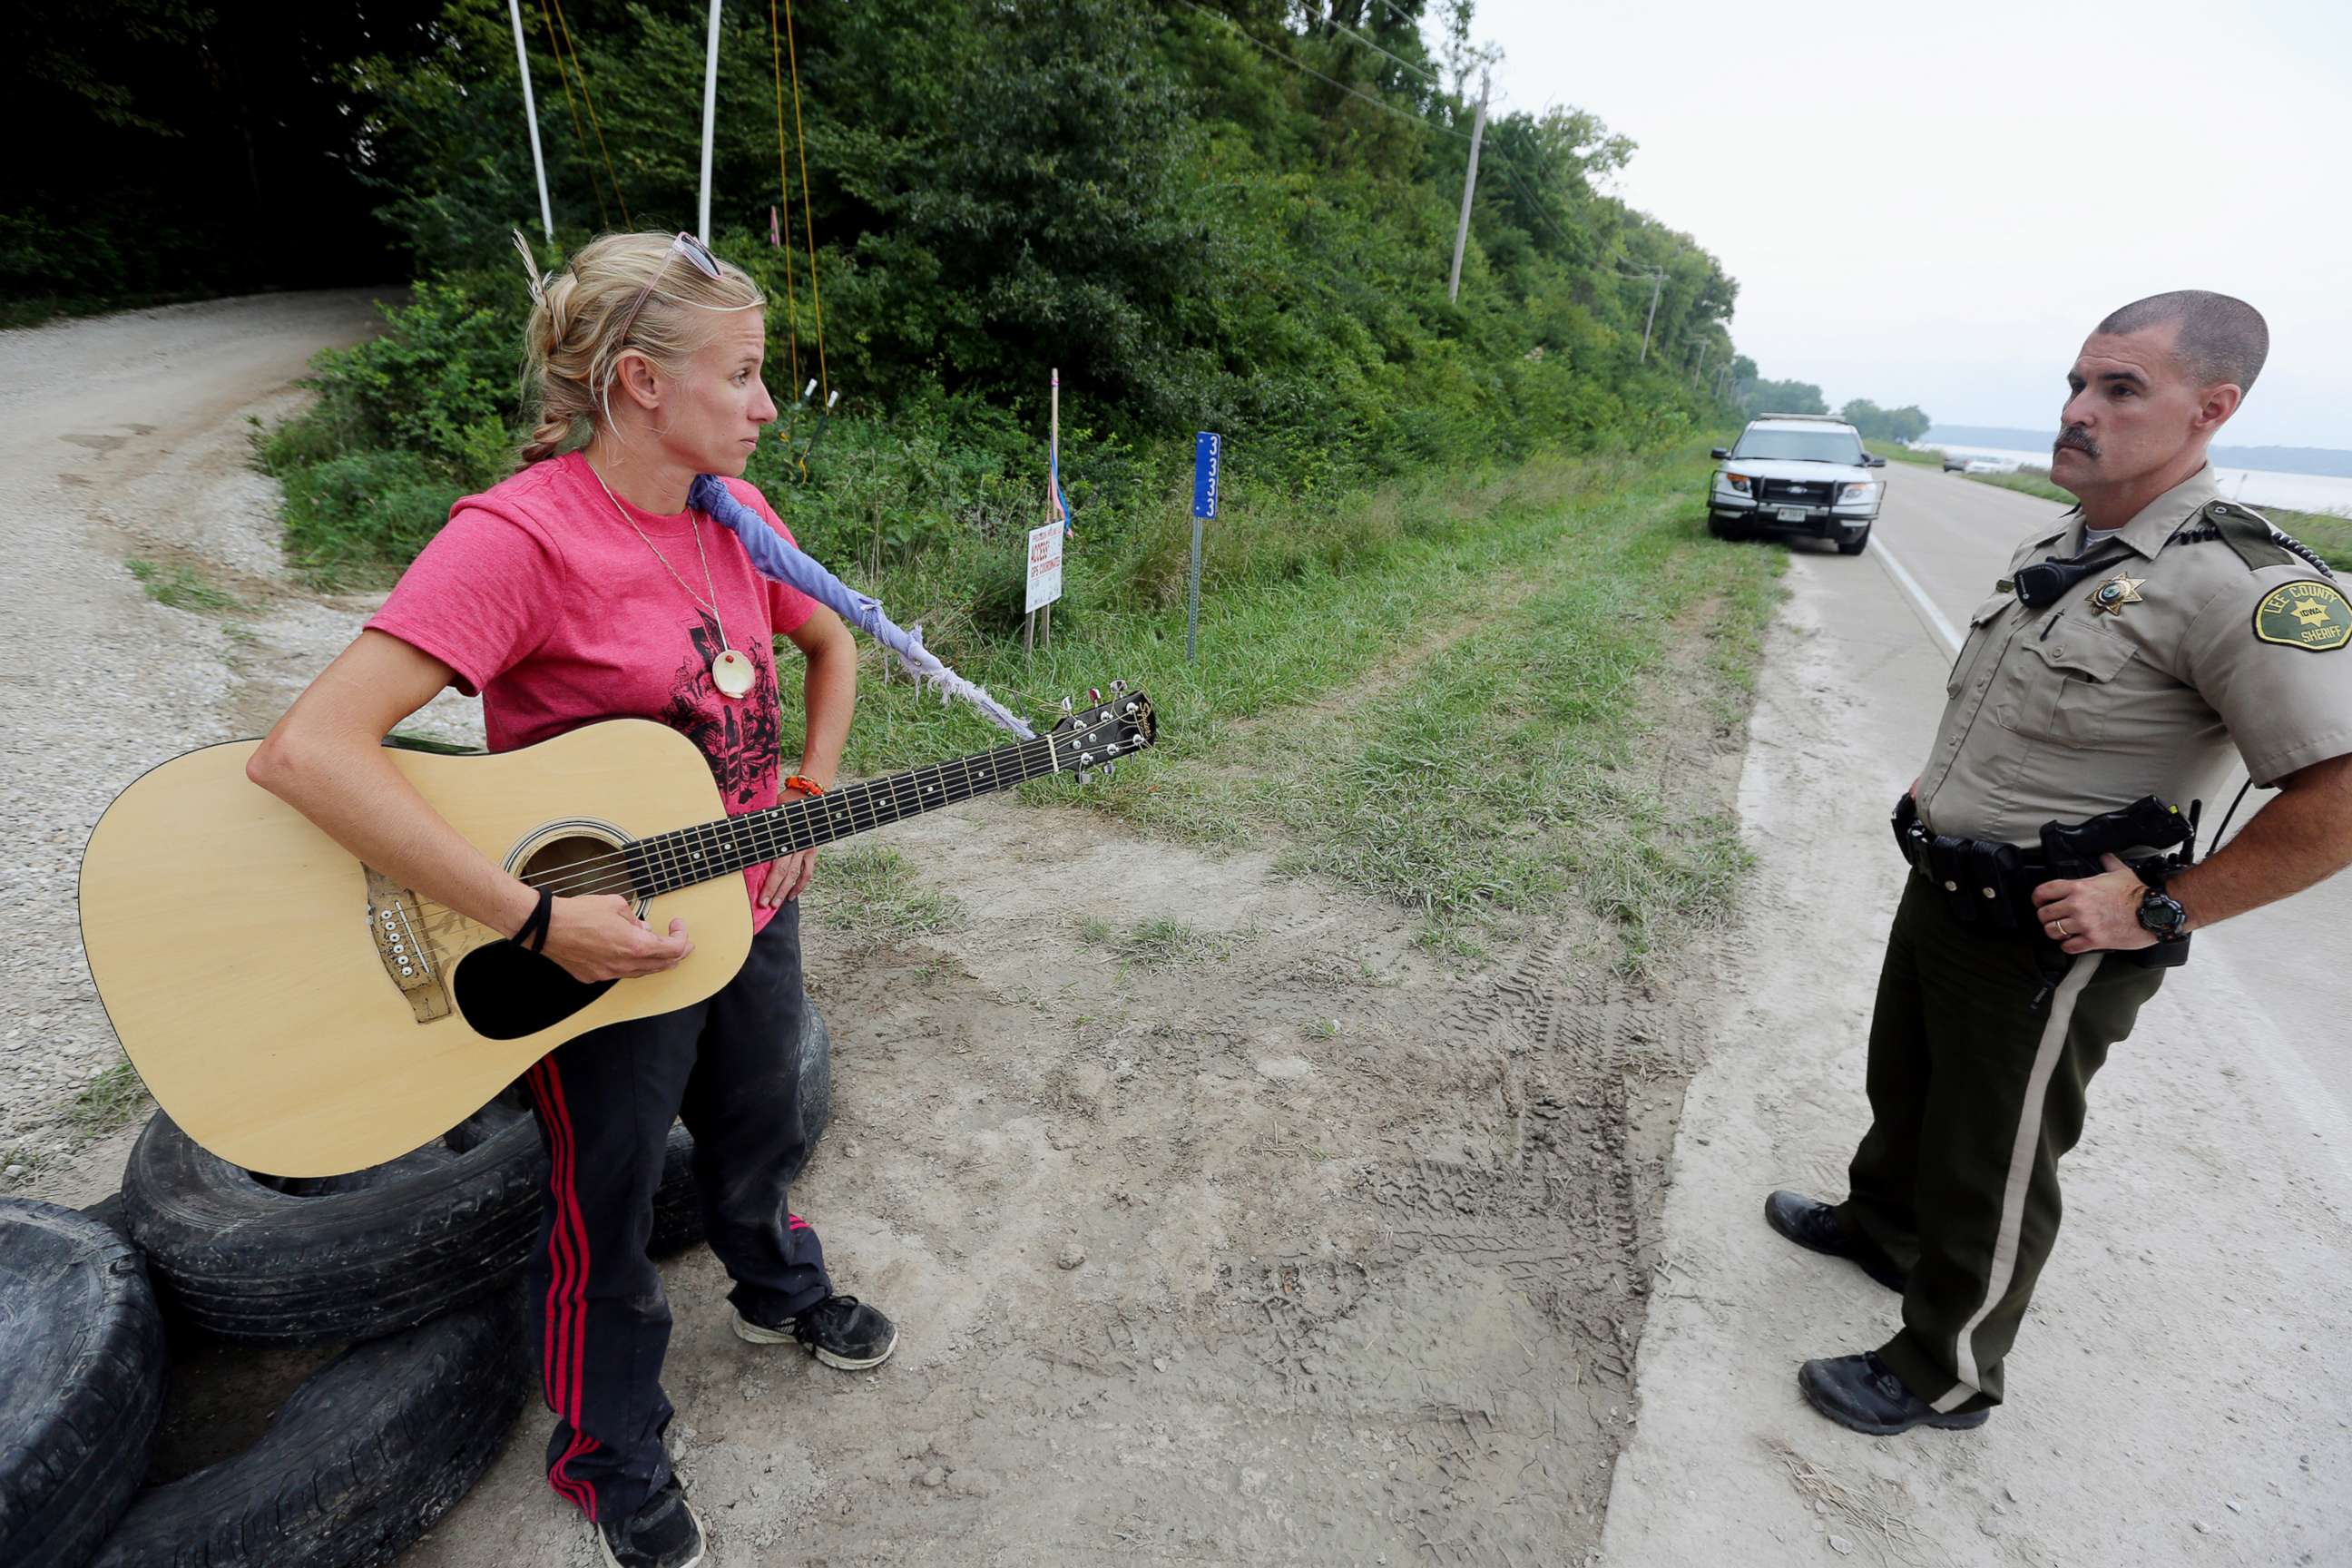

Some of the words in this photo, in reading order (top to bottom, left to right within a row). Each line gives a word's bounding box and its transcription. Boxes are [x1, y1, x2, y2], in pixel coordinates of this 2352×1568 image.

[1207, 436, 1218, 516] 3333
[1031, 565, 1039, 578] GPS
[2264, 594, 2289, 614] LEE
[2288, 585, 2338, 603] COUNTY
[2299, 608, 2322, 617] IOWA
[2300, 625, 2341, 642] SHERIFF
